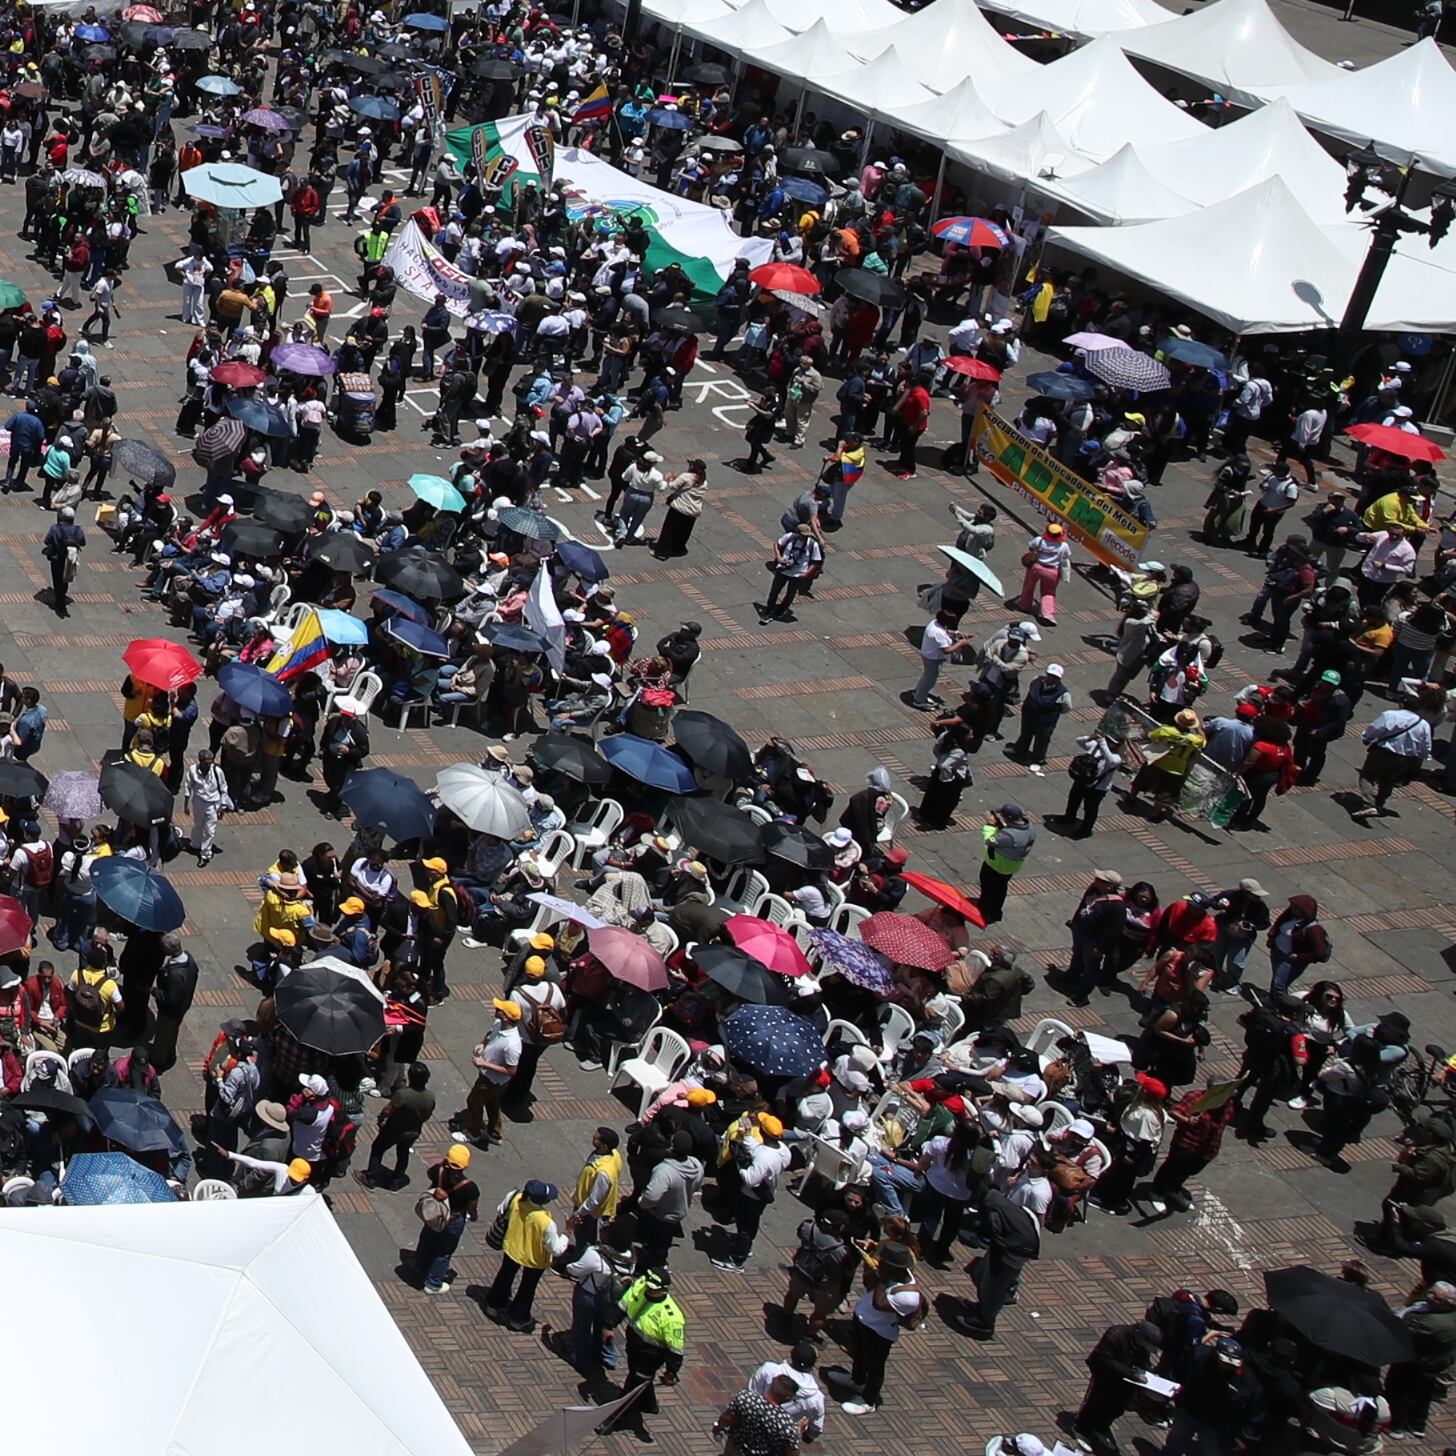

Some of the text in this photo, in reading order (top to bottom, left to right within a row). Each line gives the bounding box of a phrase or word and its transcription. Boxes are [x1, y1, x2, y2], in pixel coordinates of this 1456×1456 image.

[530, 127, 552, 172] CUT
[999, 443, 1106, 538] ADEM
[1096, 496, 1114, 517] del
[1111, 508, 1140, 536] Meta
